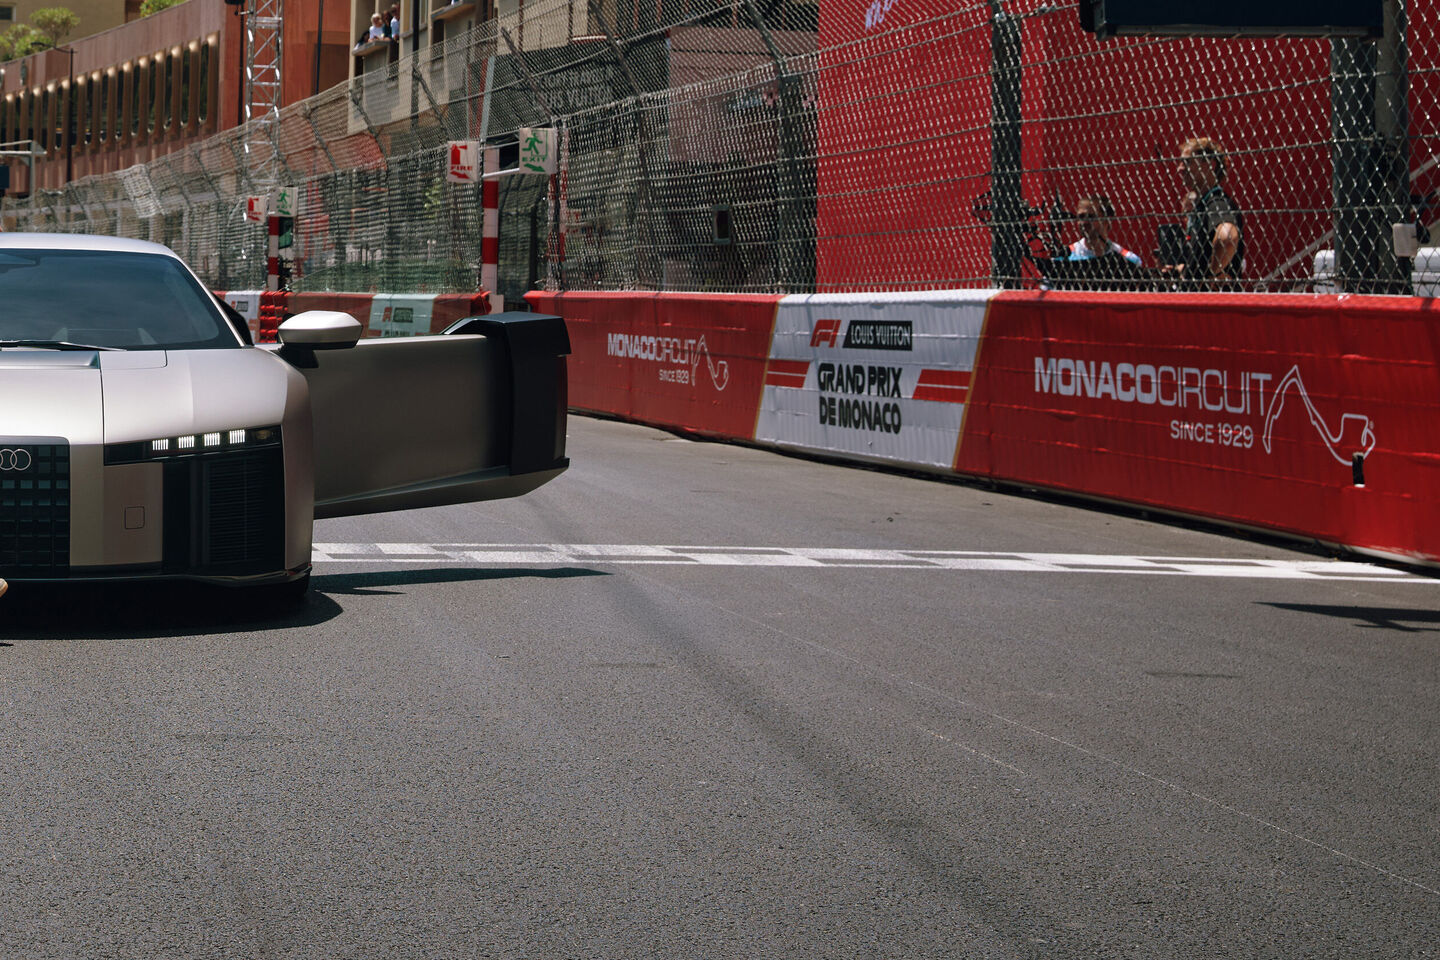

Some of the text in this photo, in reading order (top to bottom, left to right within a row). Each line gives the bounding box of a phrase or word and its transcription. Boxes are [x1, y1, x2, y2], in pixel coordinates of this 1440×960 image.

[850, 324, 874, 345] LOUIS
[875, 325, 911, 347] VUITTON
[659, 369, 689, 385] SINCE 1929
[817, 362, 902, 398] GRAND PRIX
[819, 397, 902, 434] DE MONACO
[1170, 419, 1254, 449] SINCE 1929
